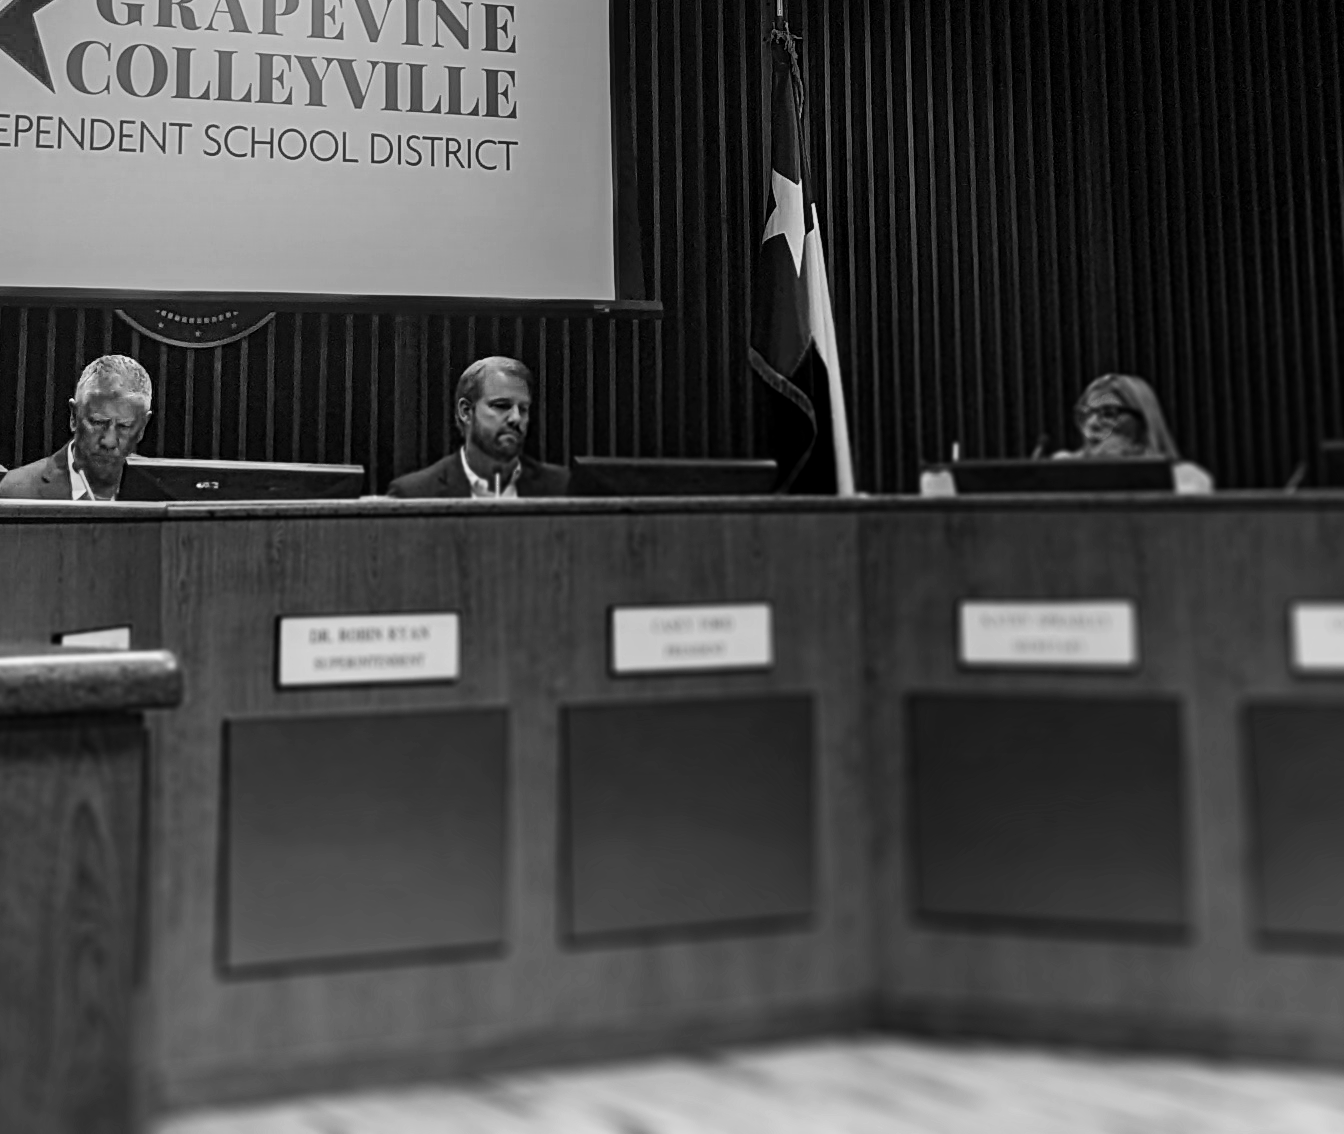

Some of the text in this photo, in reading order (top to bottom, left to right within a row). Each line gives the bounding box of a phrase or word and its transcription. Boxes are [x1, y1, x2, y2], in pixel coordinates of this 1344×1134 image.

[66, 40, 518, 120] COLLEYVILLE
[203, 123, 360, 164] SCHOOL
[370, 132, 519, 172] DISTRICT
